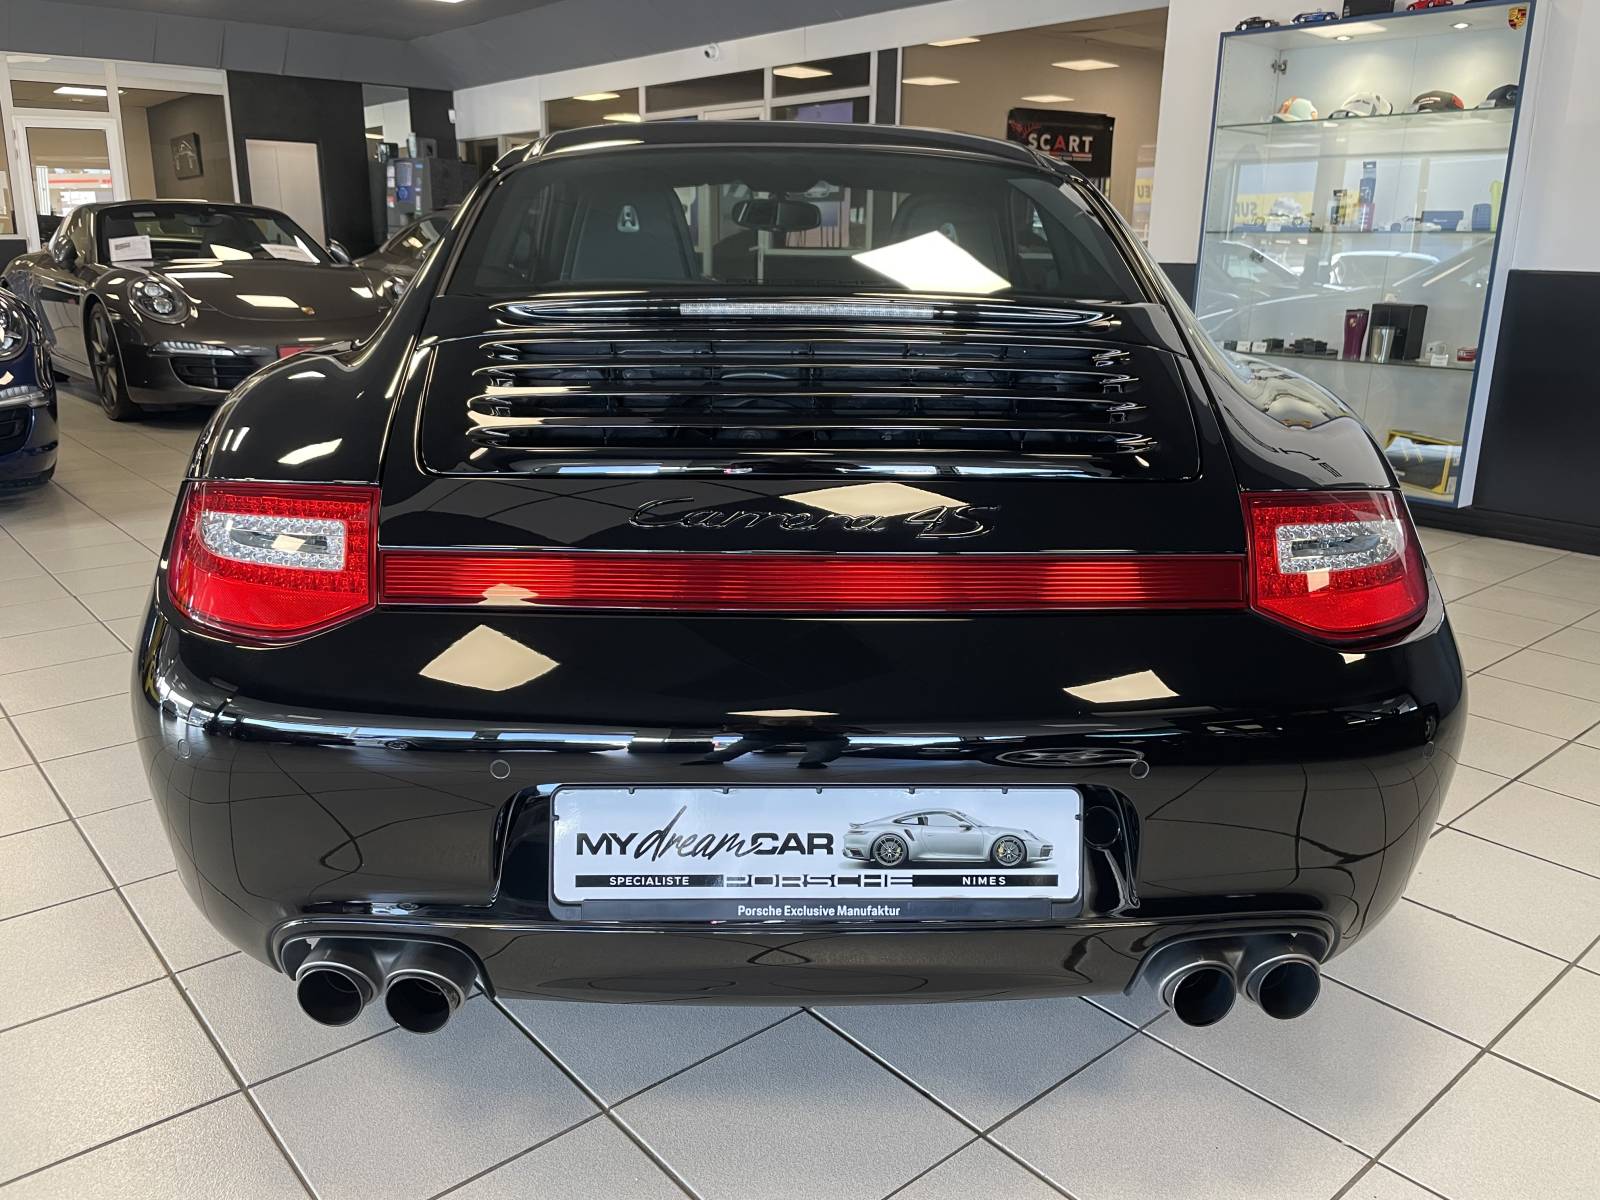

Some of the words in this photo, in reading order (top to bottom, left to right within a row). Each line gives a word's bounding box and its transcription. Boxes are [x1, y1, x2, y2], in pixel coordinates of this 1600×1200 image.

[1027, 132, 1094, 153] SCART
[628, 496, 888, 533] Carrera
[902, 504, 1000, 540] 4S
[609, 875, 690, 886] SPECIALISTE
[722, 873, 914, 888] PORSCHE
[962, 875, 1007, 886] NIMES
[737, 904, 782, 917] Porsche
[783, 904, 836, 917] Exclusive
[836, 904, 901, 917] Manufaktur
